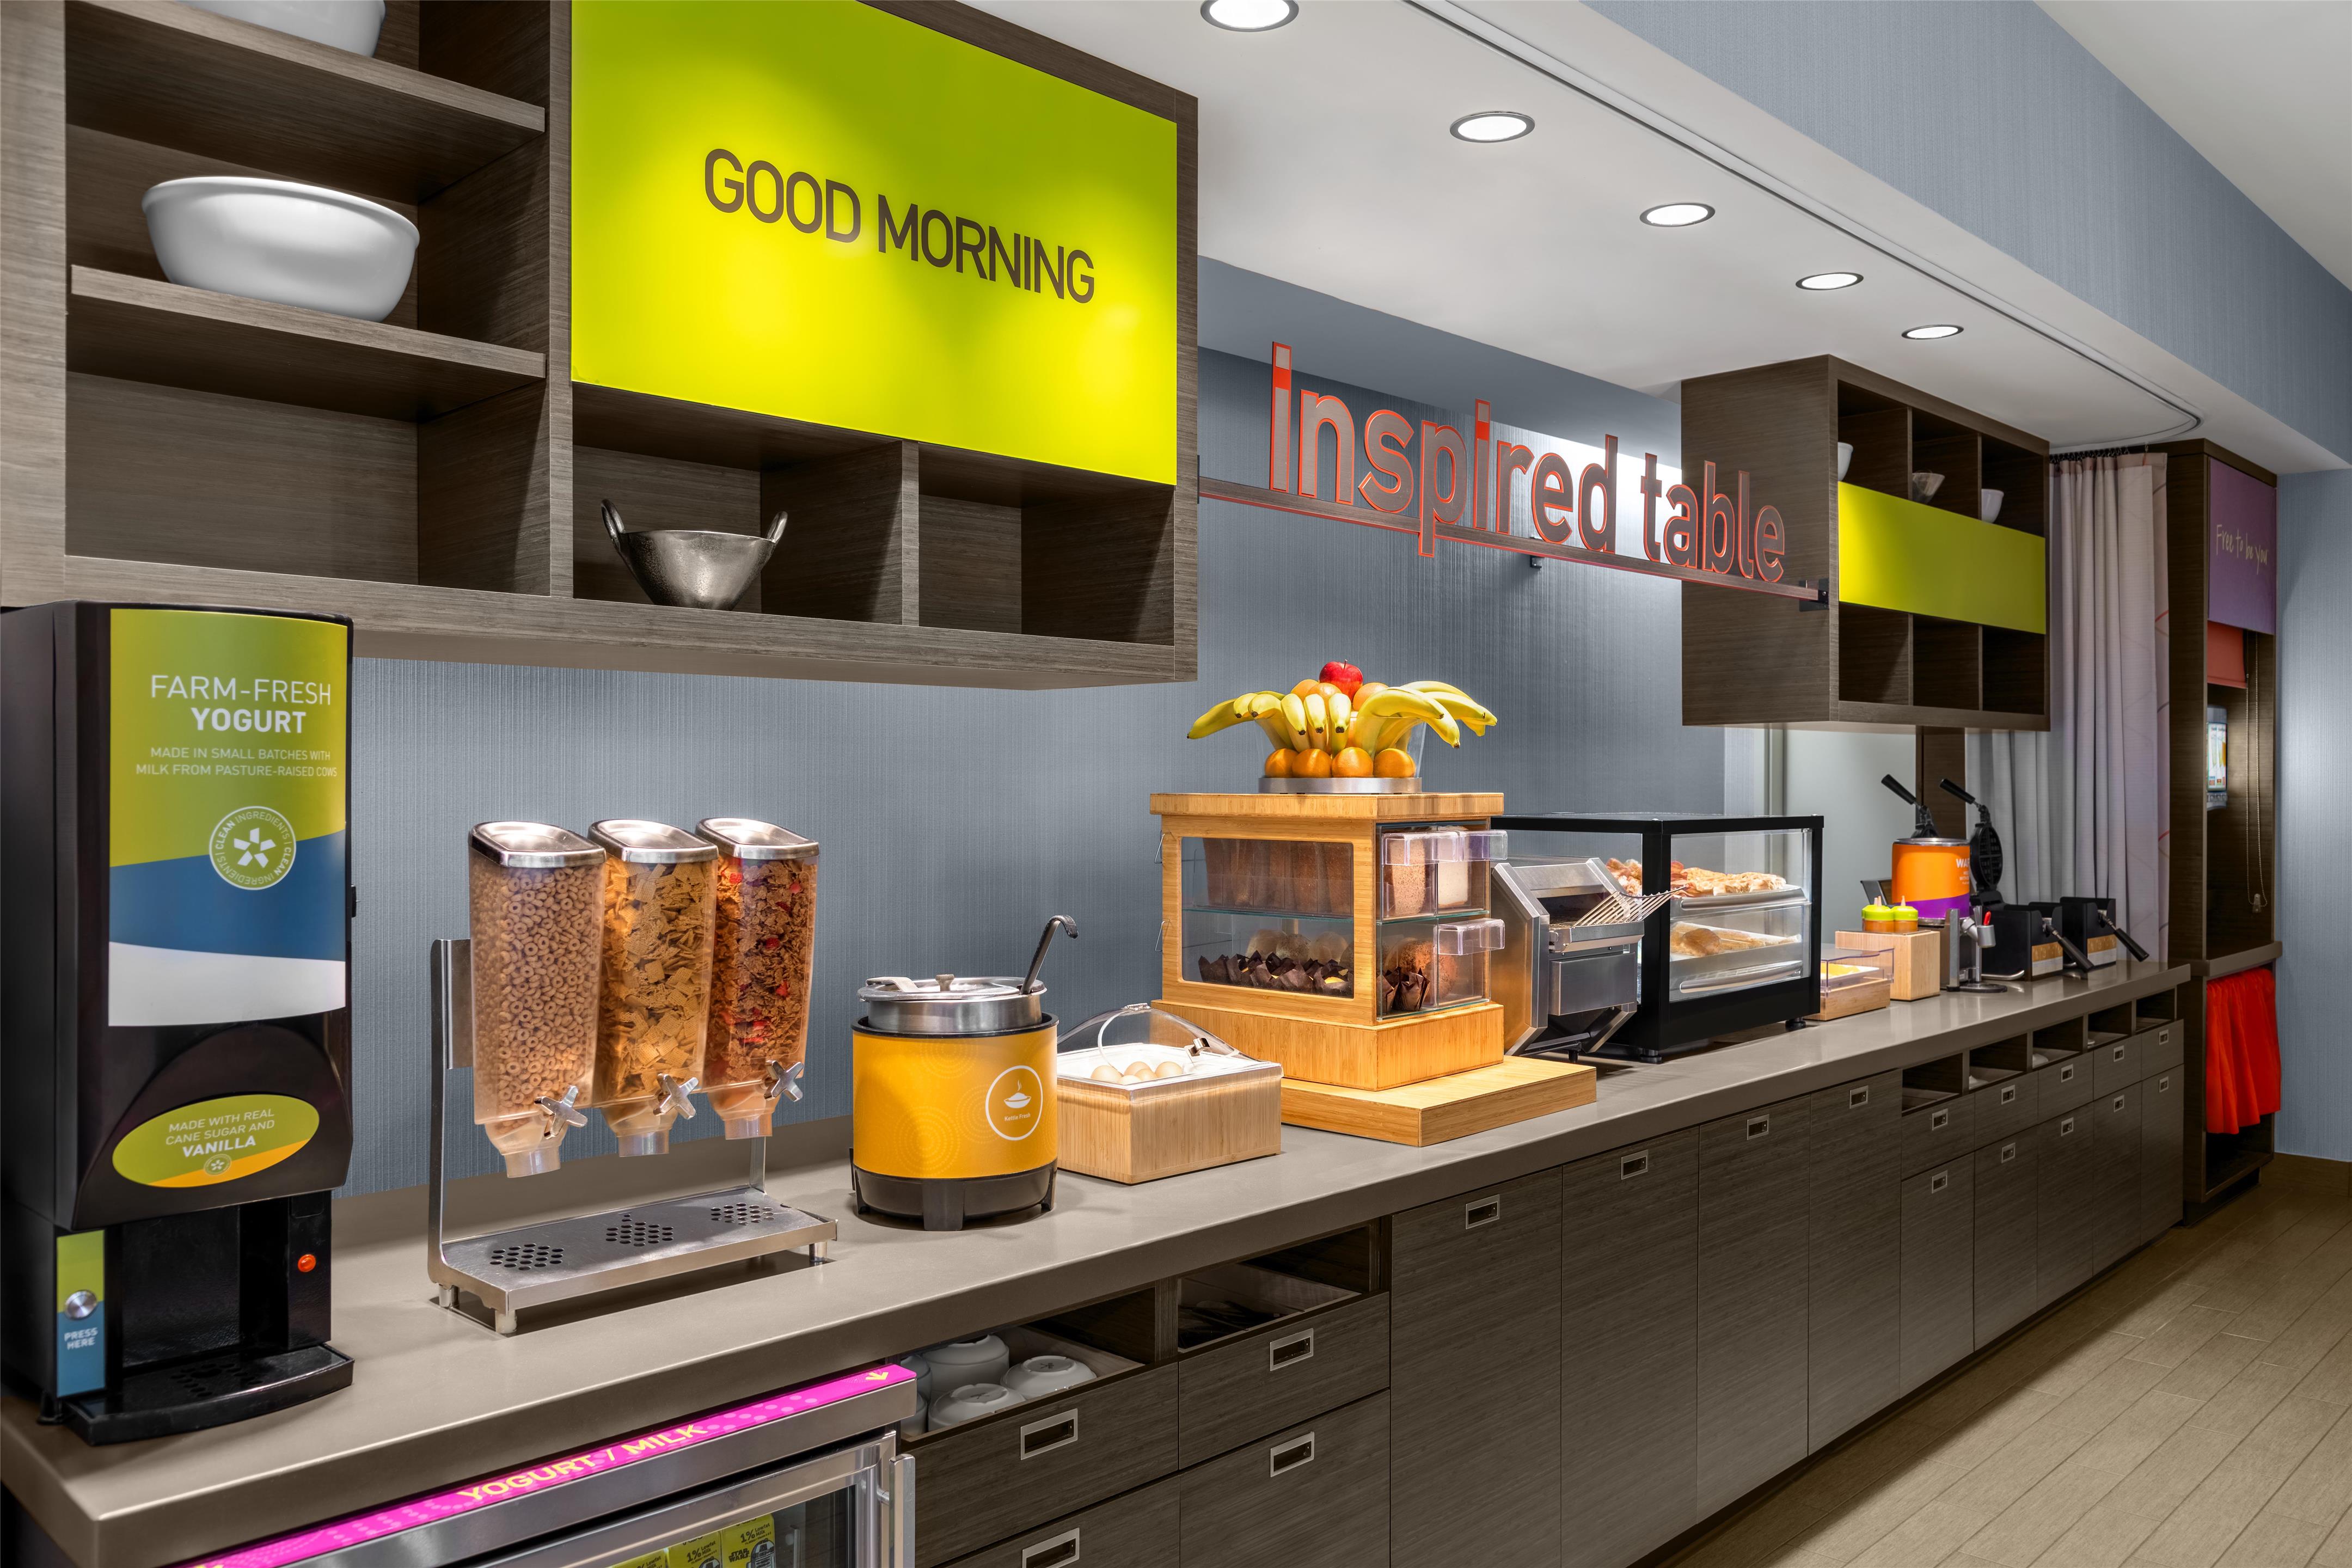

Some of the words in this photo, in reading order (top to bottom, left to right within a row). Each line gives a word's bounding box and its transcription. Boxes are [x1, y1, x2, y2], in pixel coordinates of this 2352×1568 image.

[705, 149, 861, 243] GOOD
[878, 194, 1094, 304] MORNING
[1270, 341, 1618, 558] inspired
[1640, 453, 1785, 582] table
[2216, 524, 2234, 555] Free
[2235, 528, 2243, 558] to
[2246, 532, 2253, 560] be
[2255, 544, 2269, 575] you
[151, 675, 330, 705] FARM-FRESH
[191, 707, 306, 733] YOGURT
[151, 748, 189, 758] MADE
[193, 748, 207, 758] IN
[211, 748, 255, 759] SMALL
[259, 749, 308, 761] BATCHES
[310, 750, 330, 761] WITH
[136, 764, 169, 774] MILK
[173, 764, 211, 775] FROM
[215, 765, 314, 776] PASTURE-RAISED
[316, 767, 338, 777] COWS
[215, 820, 236, 850] CLEAN
[235, 811, 291, 840] INGREDIENTS
[217, 855, 275, 885] INGREDIENTS
[273, 847, 292, 875] CLEAN
[166, 1131, 201, 1145] CANE
[204, 1125, 246, 1139] SUGAR
[249, 1119, 275, 1132] AND
[169, 1119, 206, 1132] MADE
[209, 1113, 240, 1126] WITH
[244, 1108, 274, 1120] REAL
[182, 1135, 256, 1157] VANILLA
[64, 1327, 98, 1342] PRESS
[67, 1337, 95, 1350] HERE
[456, 1455, 596, 1501] YOGURT
[621, 1424, 708, 1455] MILK
[740, 1529, 756, 1543] 1%
[755, 1523, 770, 1533] Lowfat
[687, 1547, 702, 1563] 1%
[728, 1552, 750, 1563] WARS
[731, 1548, 749, 1557] STAR
